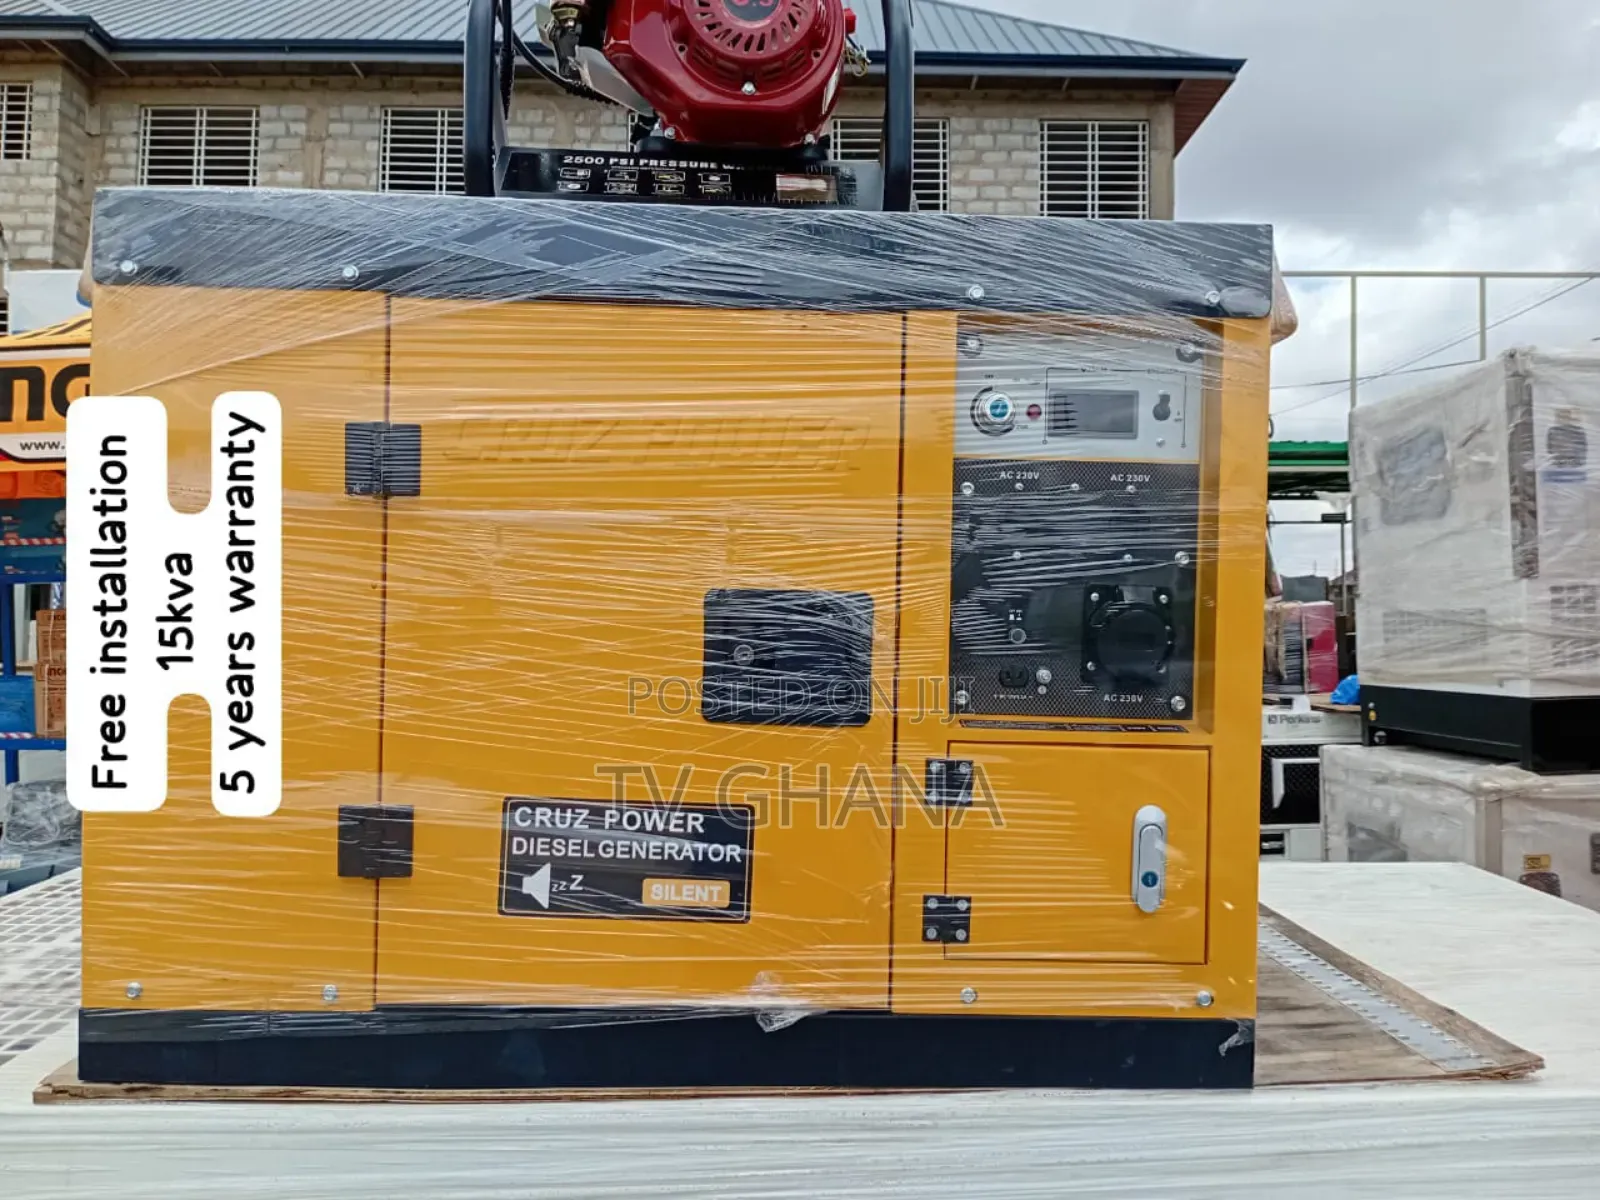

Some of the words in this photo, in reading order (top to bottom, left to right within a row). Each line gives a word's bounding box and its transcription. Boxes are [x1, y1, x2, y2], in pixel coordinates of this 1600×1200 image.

[563, 155, 605, 165] 2500
[609, 157, 635, 165] PSI
[639, 159, 719, 170] PRESSURE
[1000, 471, 1014, 480] AC
[1015, 471, 1040, 480] 230V
[1110, 474, 1125, 482] AC
[1126, 474, 1151, 482] 230V
[514, 806, 590, 830] CRUZ
[604, 809, 706, 833] POWER
[511, 836, 596, 858] DIESEL
[598, 839, 742, 863] GENERATOR
[650, 883, 722, 903] SILENT
